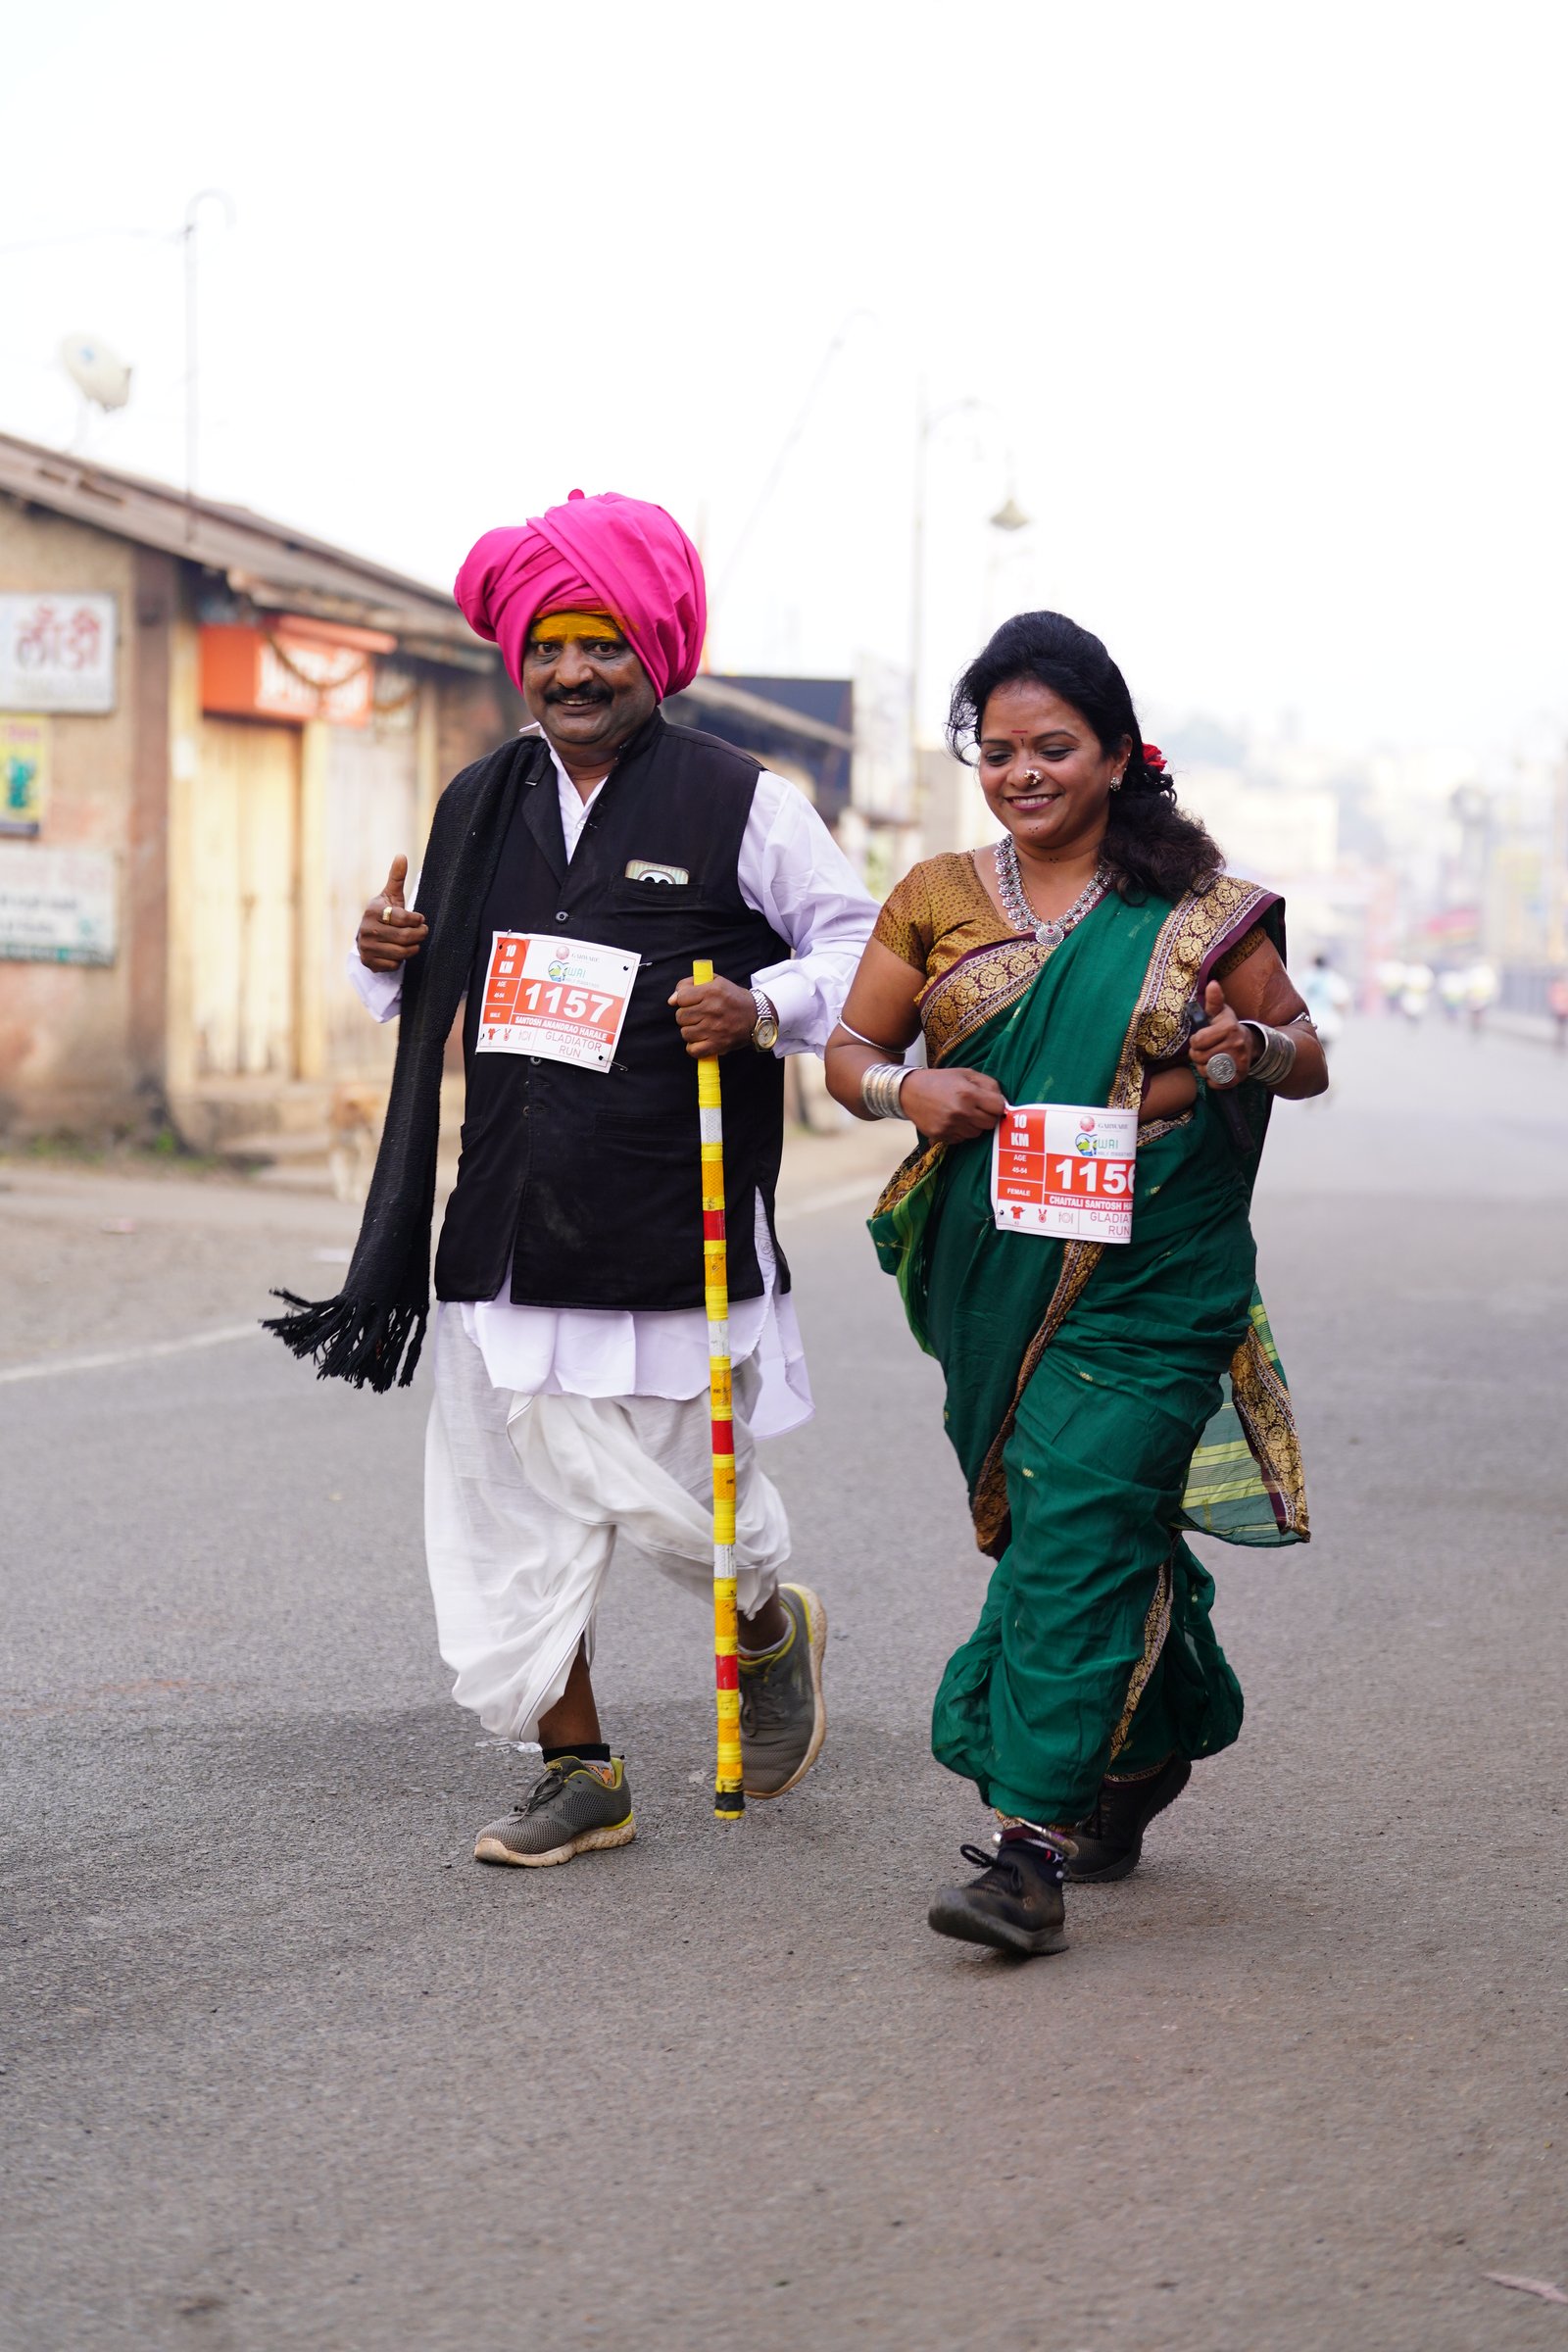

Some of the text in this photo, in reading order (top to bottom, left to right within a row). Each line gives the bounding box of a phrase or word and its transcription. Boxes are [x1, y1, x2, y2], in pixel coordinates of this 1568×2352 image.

[506, 944, 516, 957] 10
[498, 960, 514, 974] KM
[566, 966, 586, 979] WAI
[525, 983, 613, 1023] 1157
[514, 1015, 608, 1041] SANTOSH ANANDRAO HARALE
[545, 1031, 602, 1053] GLADIATOR
[559, 1045, 581, 1058] RUN
[1013, 1114, 1027, 1129] 10
[1010, 1132, 1029, 1148] KM
[1098, 1139, 1118, 1150] WAI
[1006, 1187, 1031, 1197] FEMALE
[1049, 1195, 1084, 1207] CHAITALI
[1085, 1200, 1122, 1210] SANTOSH
[1108, 1225, 1130, 1236] RUN
